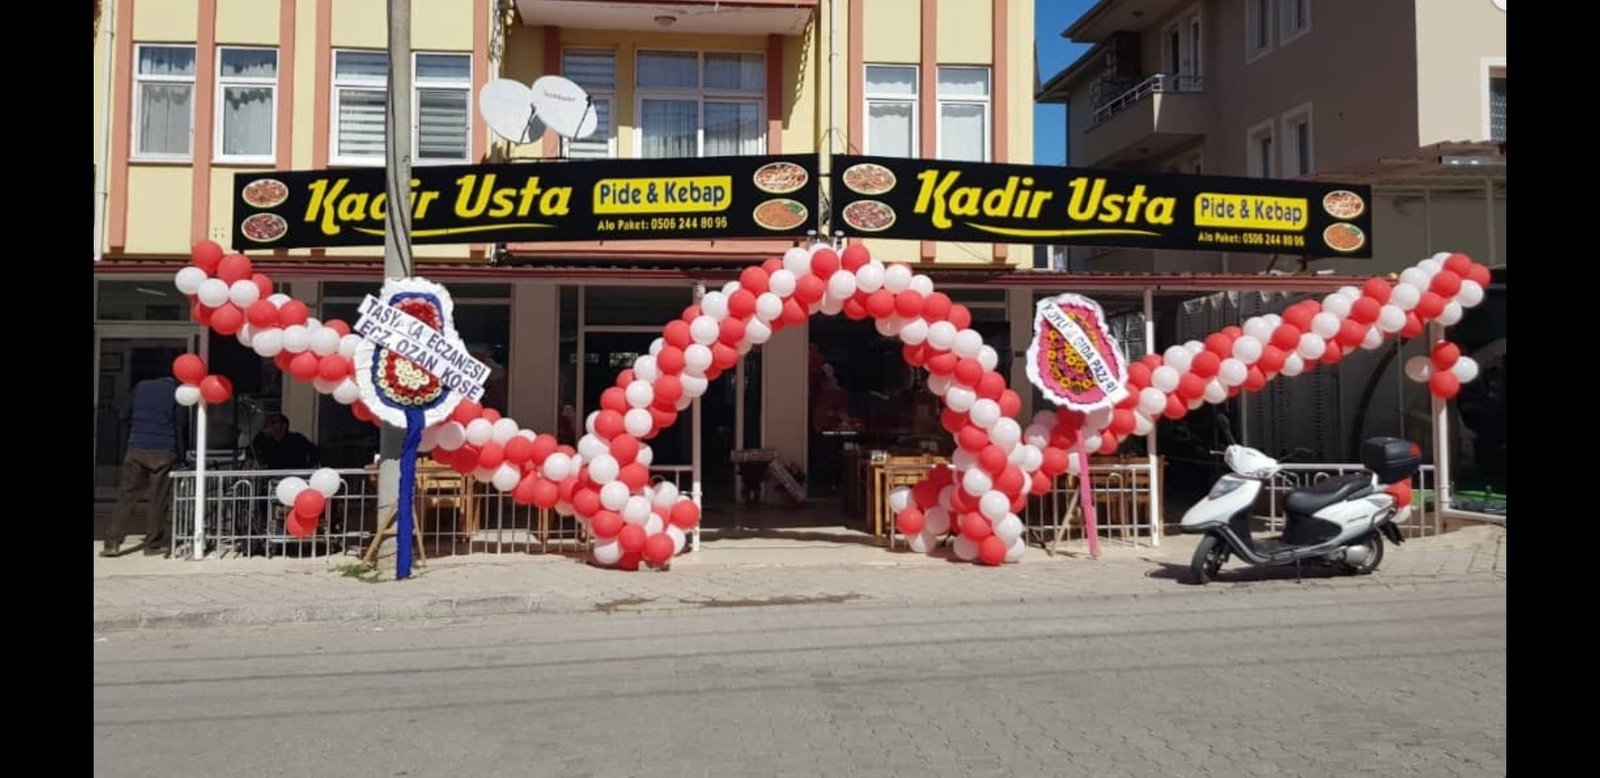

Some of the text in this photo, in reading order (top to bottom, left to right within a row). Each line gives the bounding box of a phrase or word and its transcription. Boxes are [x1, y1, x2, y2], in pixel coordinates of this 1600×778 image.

[455, 174, 573, 219] Usta
[600, 180, 725, 207] Pide & Kebap
[913, 169, 1177, 229] Kadir Usta
[597, 215, 728, 231] Alo Paket: 0506 244 80 96
[1200, 196, 1302, 226] Pide & Kebap
[1197, 231, 1213, 242] Alo
[366, 299, 424, 340] TASYKA
